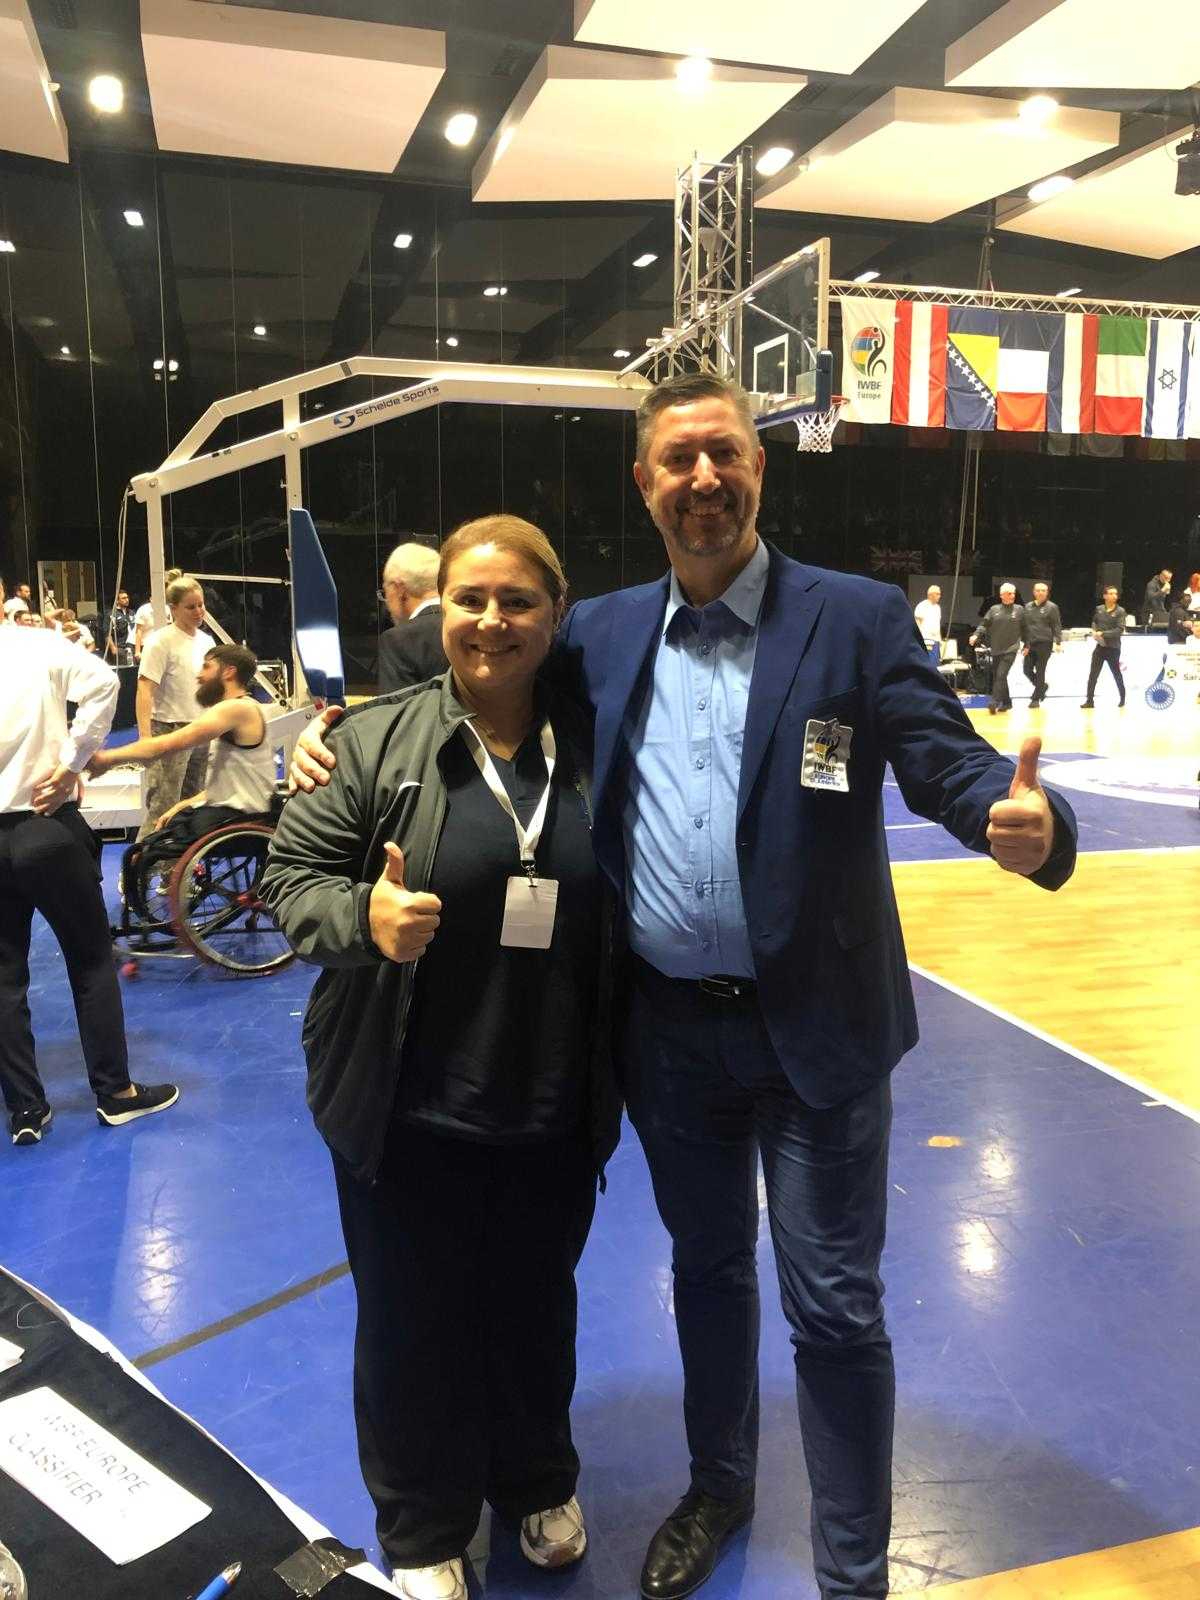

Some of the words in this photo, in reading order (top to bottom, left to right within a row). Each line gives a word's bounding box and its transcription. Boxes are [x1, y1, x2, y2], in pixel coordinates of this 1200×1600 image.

[402, 385, 440, 402] Sports
[857, 380, 881, 390] IWBF
[857, 391, 881, 400] Europe
[8, 1431, 103, 1505] CLASSIFIER
[76, 1438, 150, 1496] EUROPE
